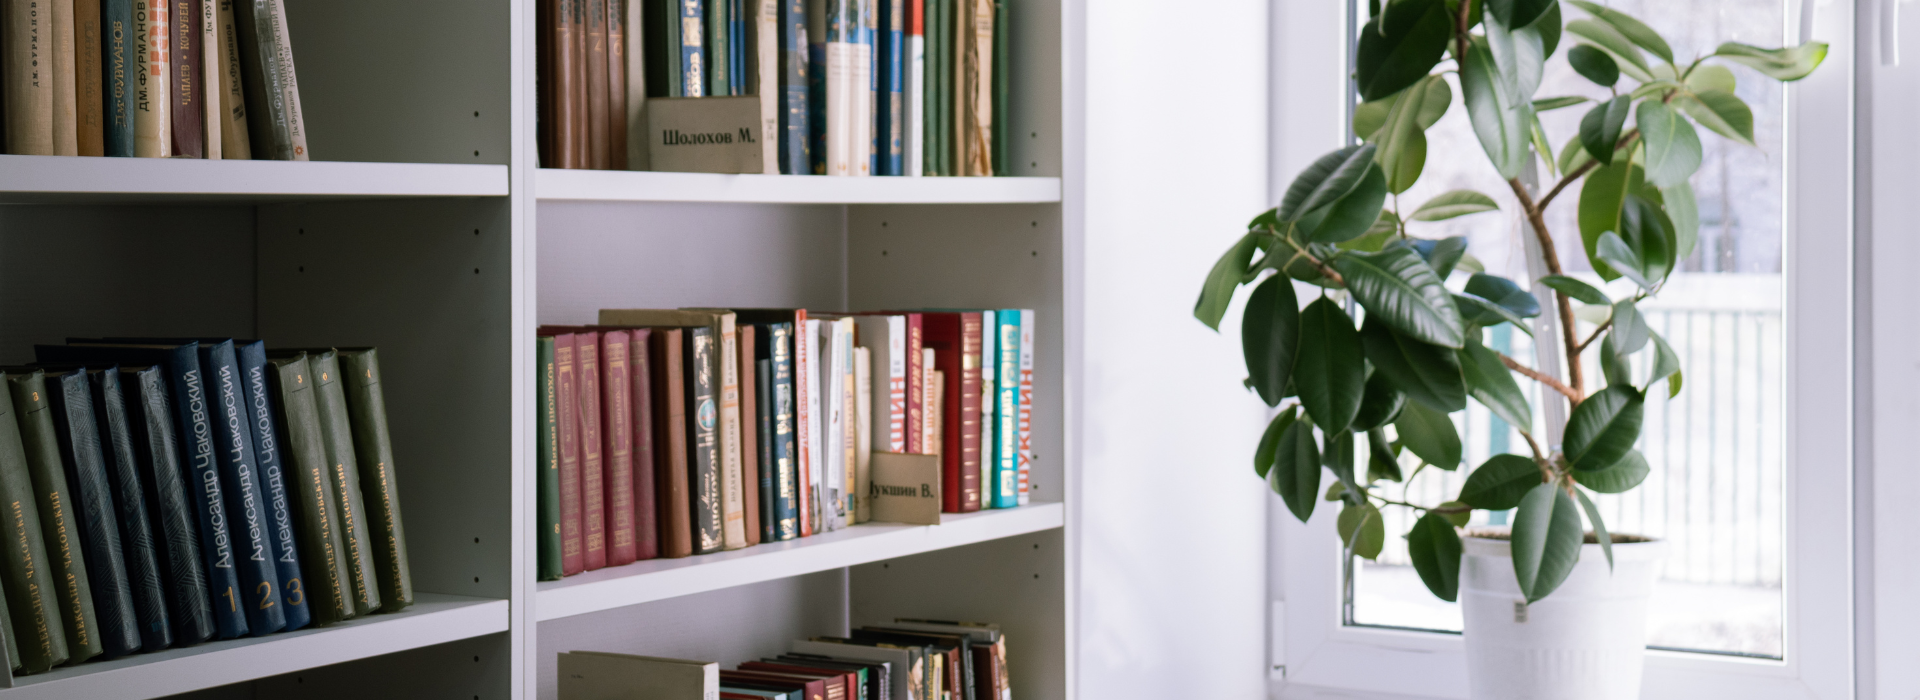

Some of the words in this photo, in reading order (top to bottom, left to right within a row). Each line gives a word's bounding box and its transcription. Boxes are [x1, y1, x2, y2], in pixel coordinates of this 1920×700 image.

[178, 2, 189, 50] КОЧУБЕЙ
[270, 13, 283, 51] КРАСНЫЙ
[181, 64, 191, 106] ЧАПАЕВ
[663, 129, 733, 145] Шолохов
[738, 127, 756, 143] М.
[183, 369, 211, 469] Чаковский
[219, 365, 243, 462] Чаковский
[249, 366, 274, 464] Чаковский
[1018, 369, 1032, 492] ШУКШИН
[203, 470, 232, 568] Александр
[238, 464, 265, 561] Александр
[267, 465, 295, 562] Александр
[312, 468, 330, 539] ЧАКОВСКИЙ
[336, 463, 355, 533] ЧАКОВСКИЙ
[377, 462, 394, 532] ЧАКОВСКИЙ
[711, 449, 720, 531] ШОЛОХОВ
[921, 483, 934, 498] В.
[12, 500, 34, 579] ЧАКОВСКИЙ
[50, 491, 72, 569] ЧАКОВСКИЙ
[222, 586, 236, 613] 1
[256, 581, 275, 610] 2
[286, 577, 304, 606] 3
[325, 542, 343, 610] АЛЕКСАНДР
[349, 537, 368, 603] АЛЕКСАНДР
[67, 573, 88, 646] АЛЕКСАНДР
